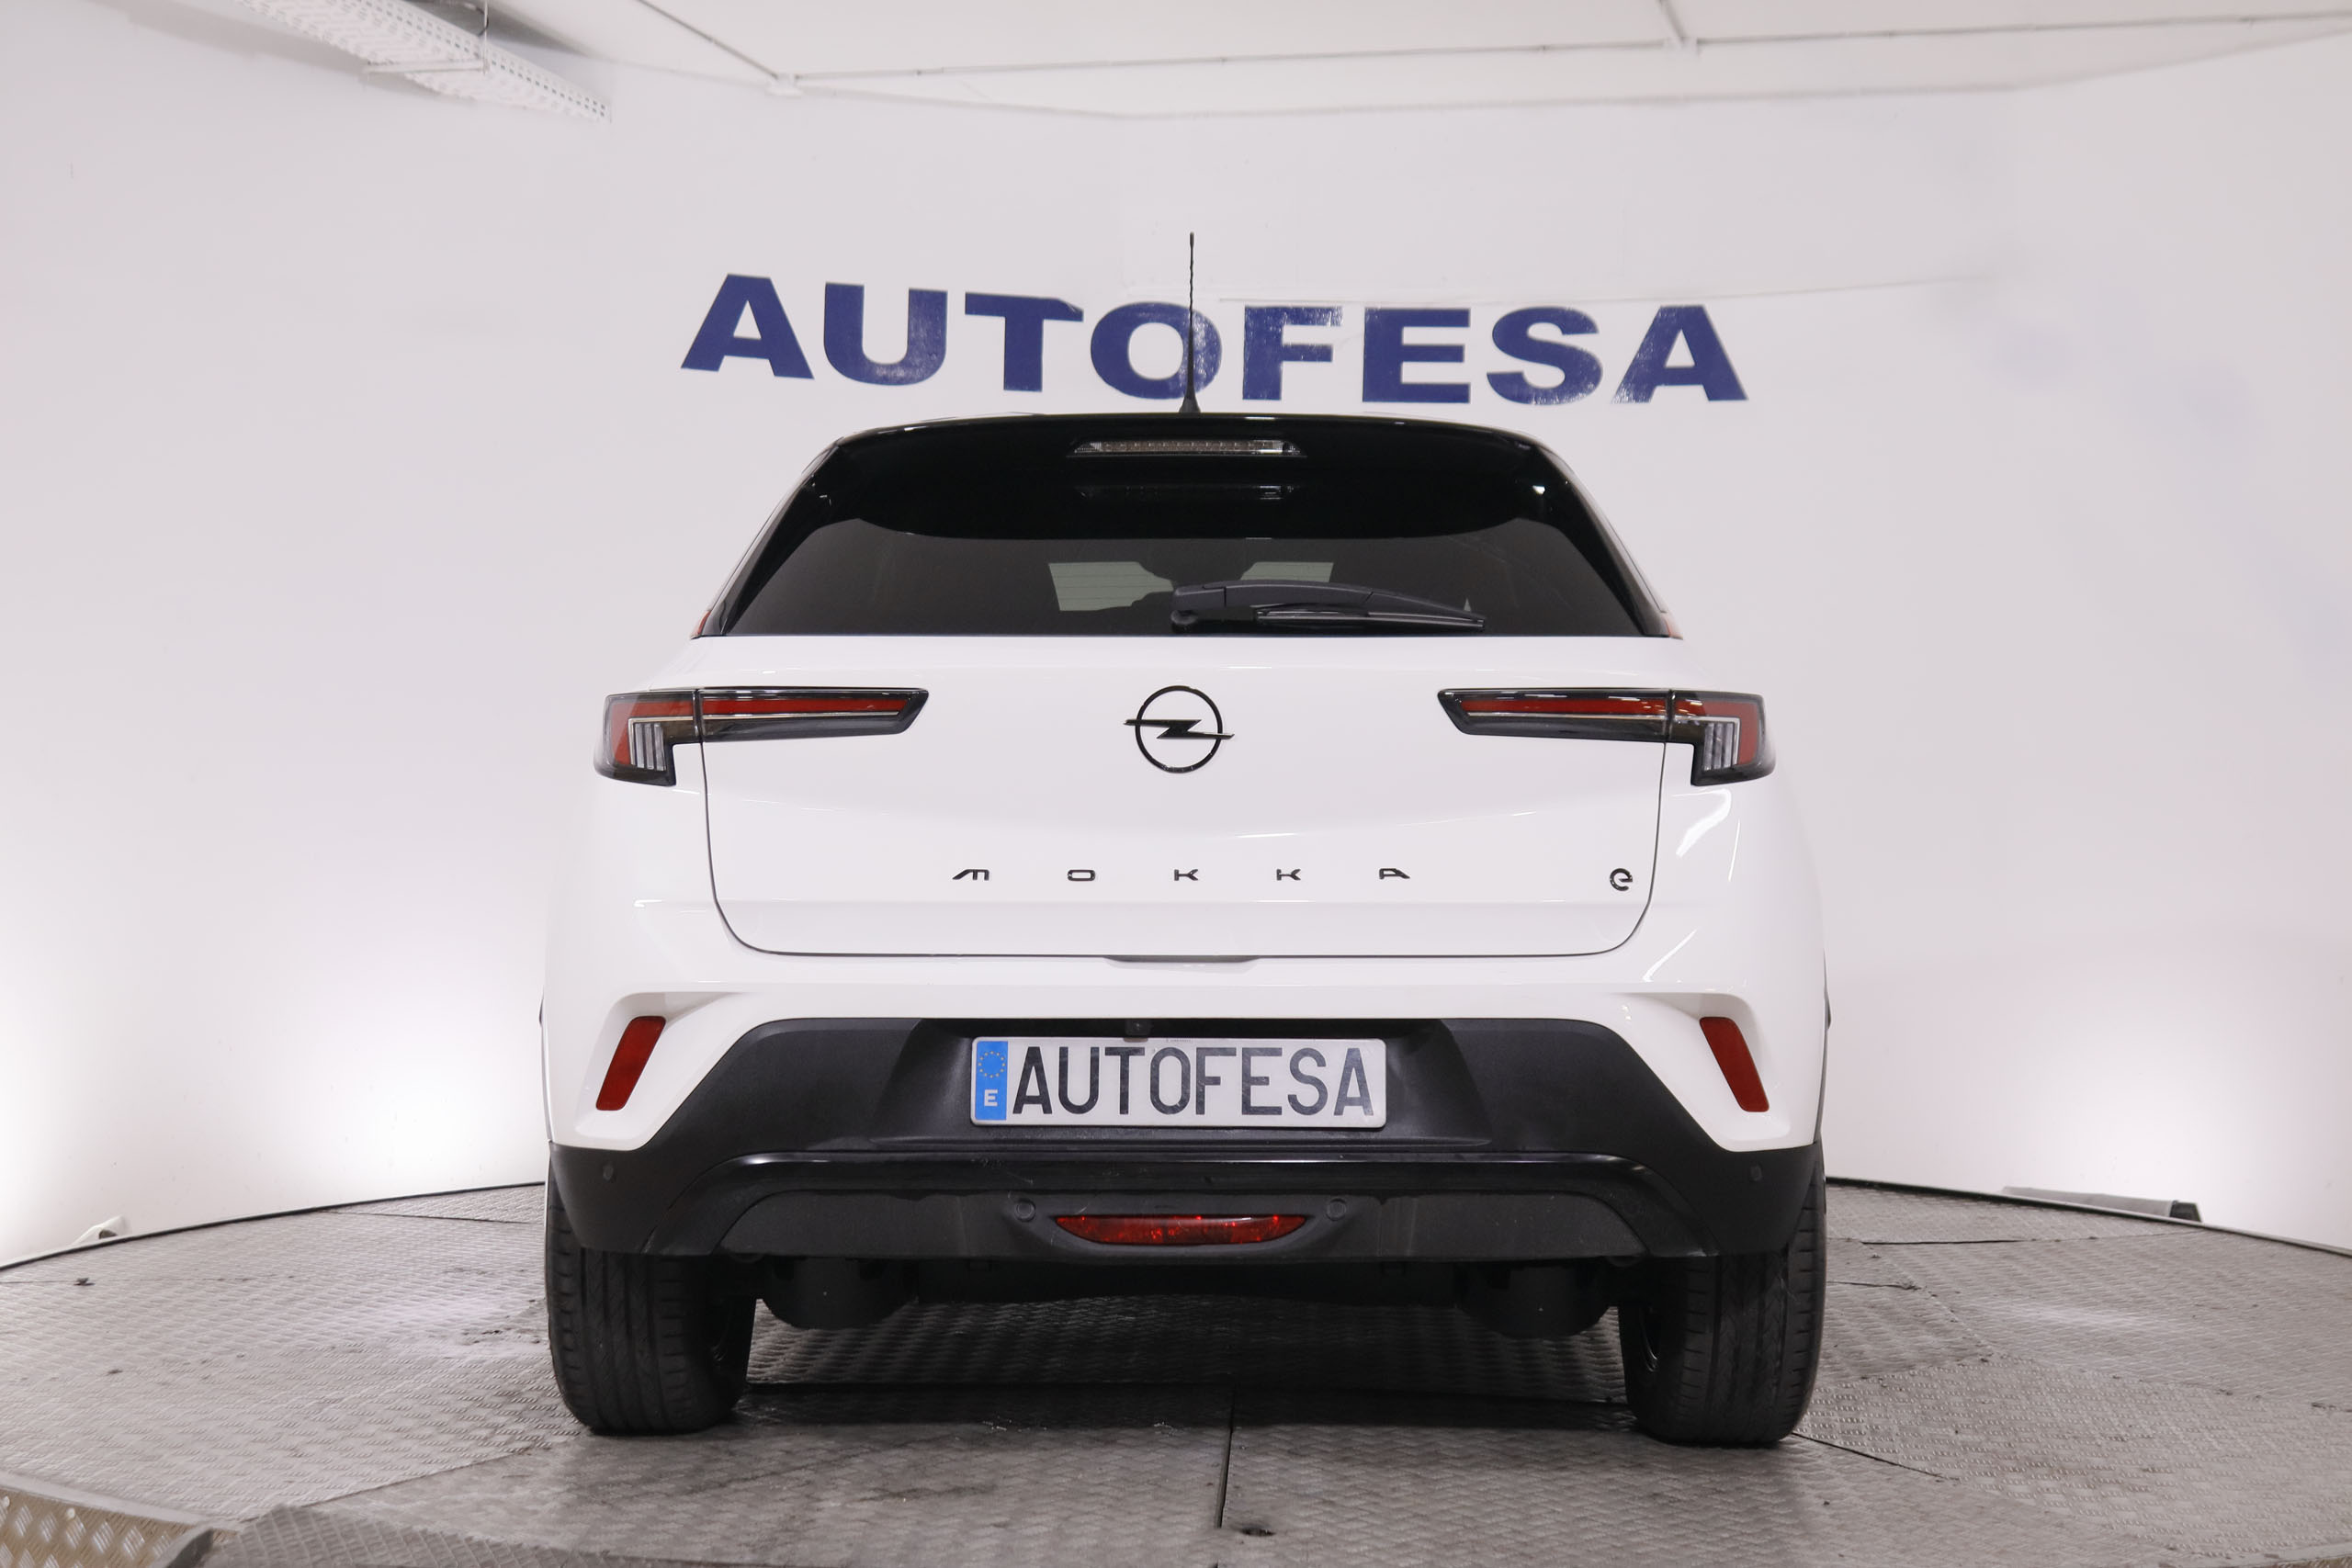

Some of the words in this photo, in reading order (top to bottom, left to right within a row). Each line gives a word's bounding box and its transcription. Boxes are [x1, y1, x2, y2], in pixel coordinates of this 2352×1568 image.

[682, 274, 1747, 405] AUTOFESA
[952, 867, 1410, 882] MOKKA
[1609, 867, 1634, 892] e
[1012, 1046, 1375, 1116] AUTOFESA
[984, 1089, 999, 1107] E
